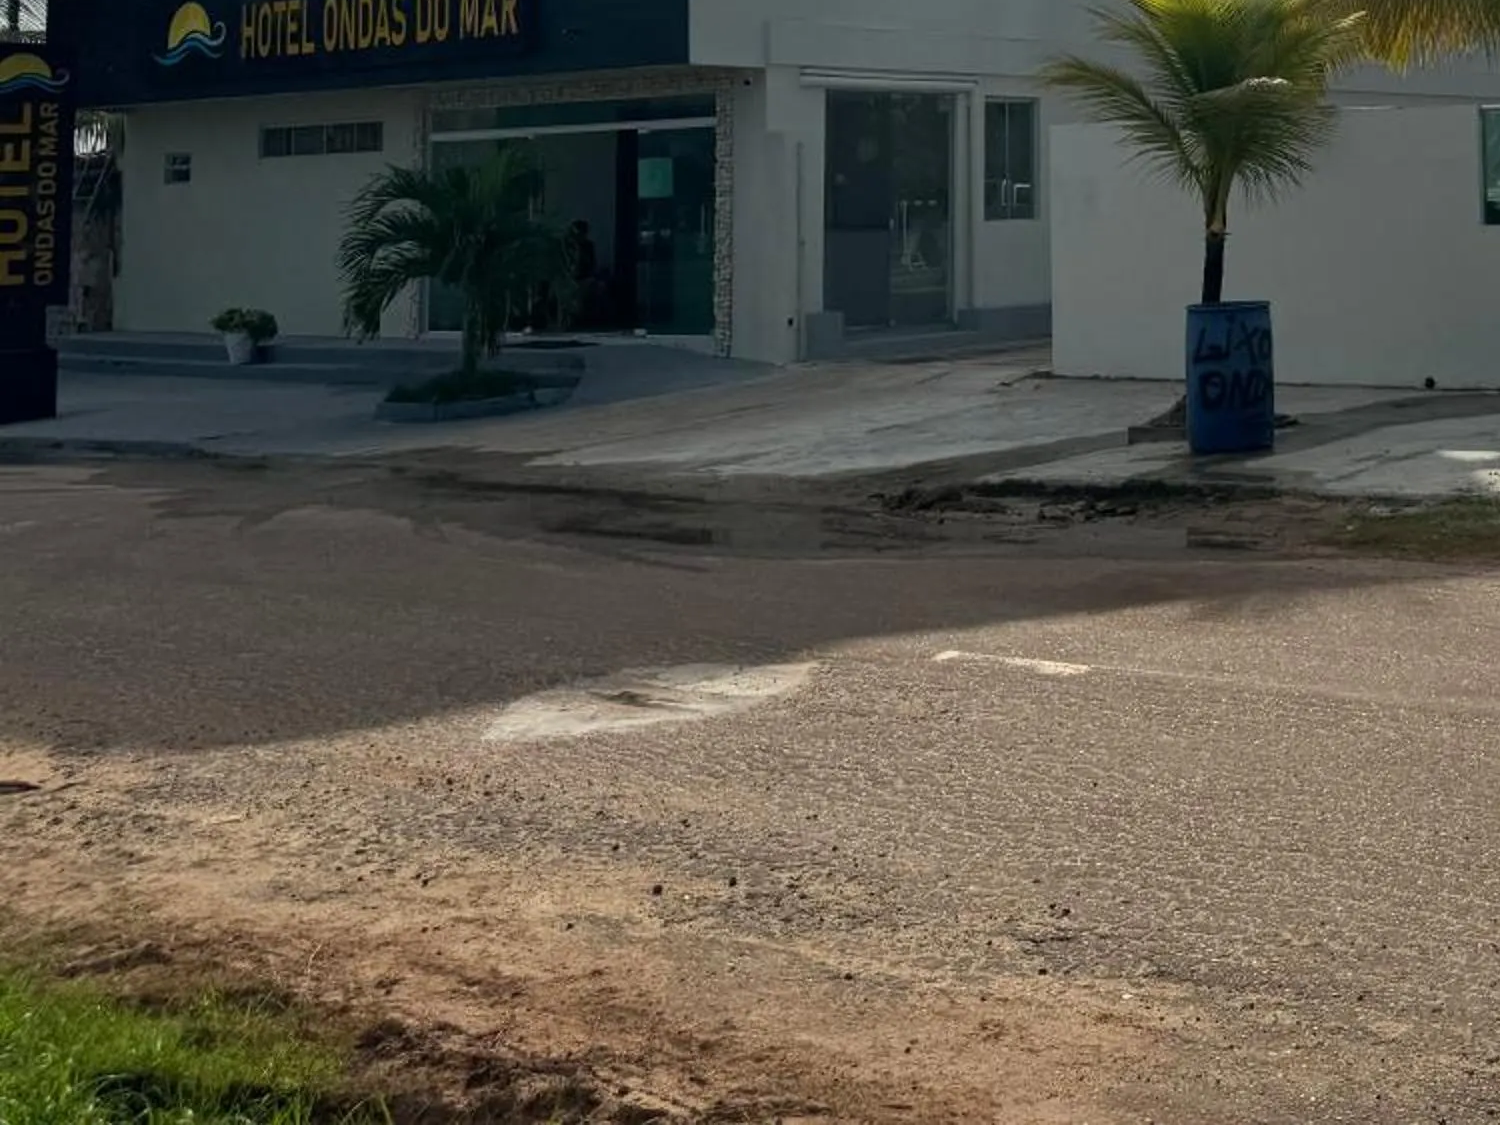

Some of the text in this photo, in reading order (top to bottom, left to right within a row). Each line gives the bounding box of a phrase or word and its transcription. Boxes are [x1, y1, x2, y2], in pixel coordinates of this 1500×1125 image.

[34, 102, 60, 286] ONDAS DO MAR
